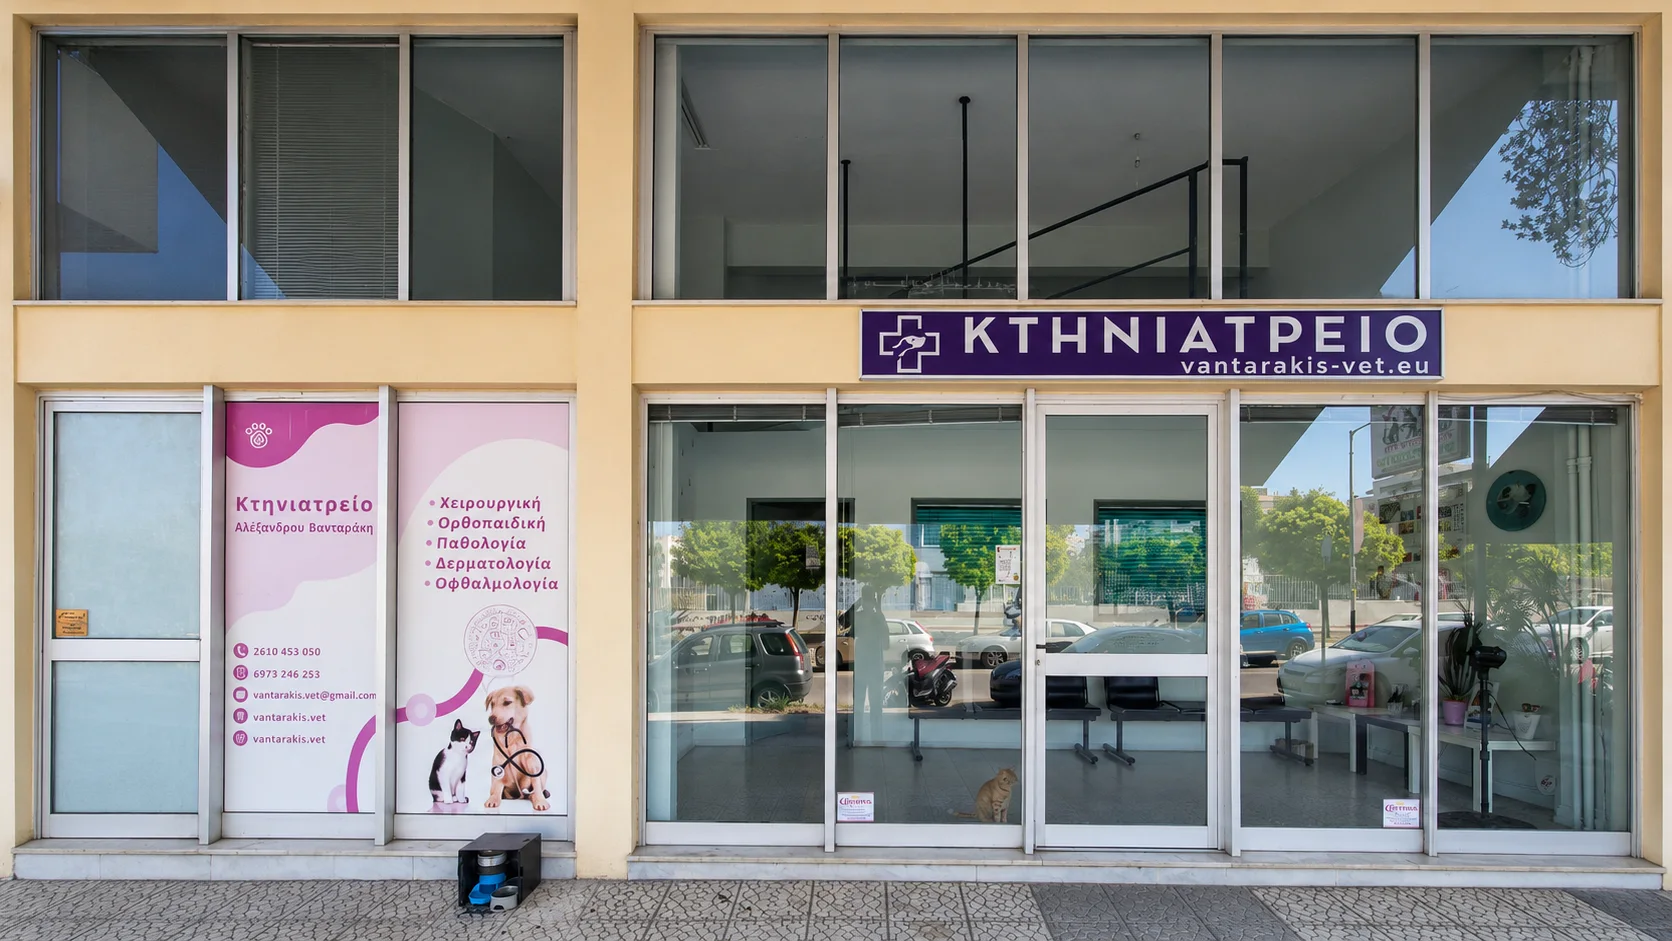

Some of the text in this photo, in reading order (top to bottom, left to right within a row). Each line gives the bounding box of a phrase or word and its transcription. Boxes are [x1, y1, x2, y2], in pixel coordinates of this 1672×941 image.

[964, 315, 1428, 354] ΚΤΗΝΙΑΤΡΕΙΟ
[1180, 356, 1429, 375] vantarakis-vet.eu
[236, 495, 373, 515] Κτηνιατρείο
[440, 496, 541, 512] Χειρουργική
[235, 521, 373, 535] Αλέξανδρου Βανταράκη
[438, 516, 546, 532] Ορθοπαιδική
[436, 536, 526, 552] Παθολογία
[435, 556, 552, 572] Δερματολογία
[435, 576, 559, 592] Οφθαλμολογία
[253, 647, 321, 656] 2610 453 050
[253, 670, 320, 679] 6973 246 253
[253, 690, 377, 702] vantarakis.vet@gmail.com
[253, 713, 326, 722] vantarakis.vet
[253, 735, 326, 744] vantarakis.vet
